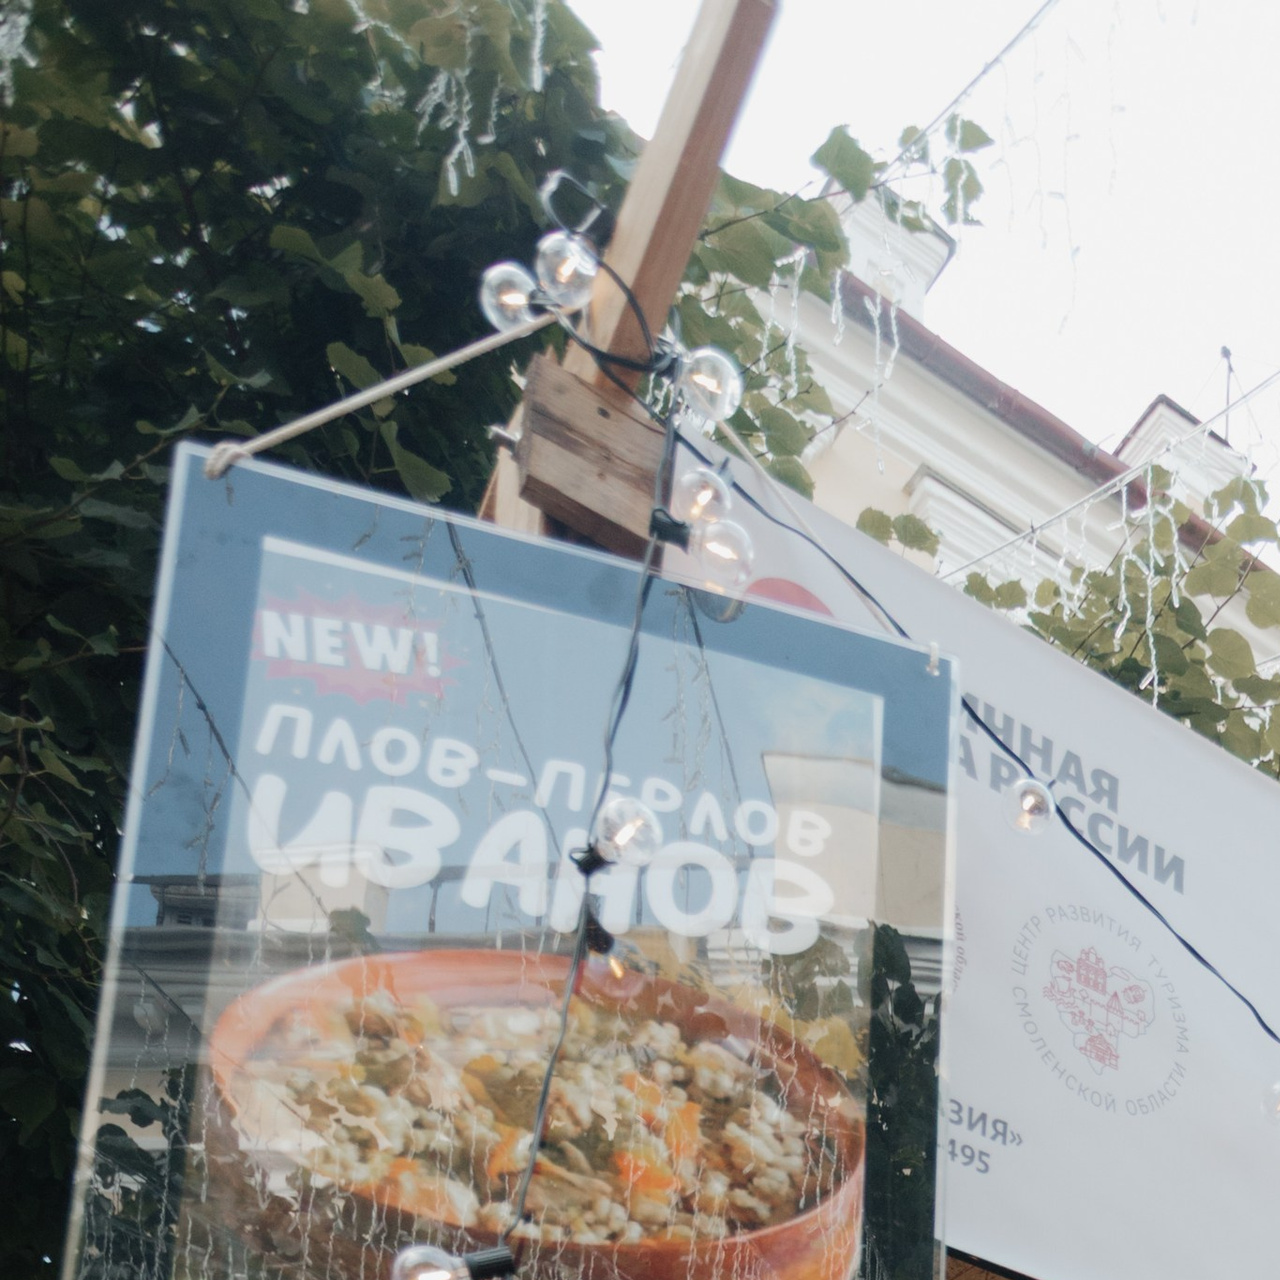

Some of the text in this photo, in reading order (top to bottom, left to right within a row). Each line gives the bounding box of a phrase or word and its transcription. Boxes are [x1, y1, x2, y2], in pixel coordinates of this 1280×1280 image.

[261, 608, 443, 678] NEW!
[247, 773, 835, 957] ИВАНОВ
[989, 752, 1185, 895] РССИИ
[1012, 904, 1190, 1055] ЦЕНТР РАЗВИТИЯ ТУРИЗМА
[1012, 986, 1187, 1116] СМОЛЕНСКОЙ ОБЛАСТИ
